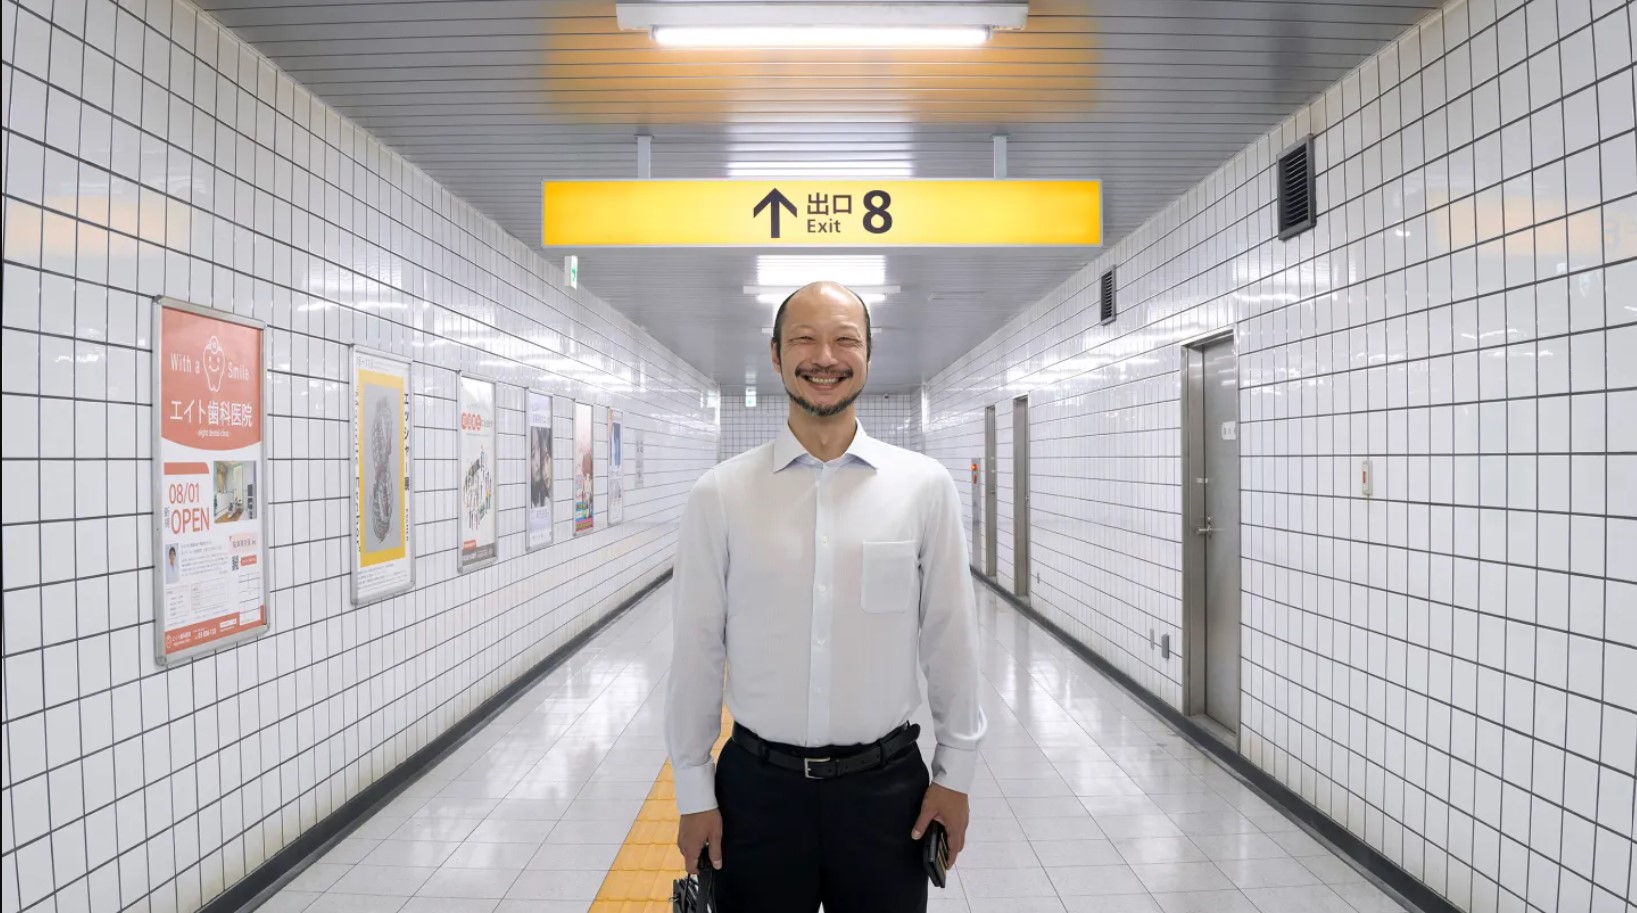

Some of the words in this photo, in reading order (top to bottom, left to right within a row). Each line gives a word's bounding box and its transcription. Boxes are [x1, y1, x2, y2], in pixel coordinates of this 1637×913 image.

[807, 192, 852, 216] 出口
[862, 189, 893, 234] 8
[807, 218, 841, 233] Exit
[170, 353, 192, 373] With
[194, 361, 200, 374] a
[227, 362, 250, 381] Smile
[170, 399, 252, 427] エイト歯科医院
[168, 483, 200, 504] 08/01
[171, 507, 210, 534] OPEN
